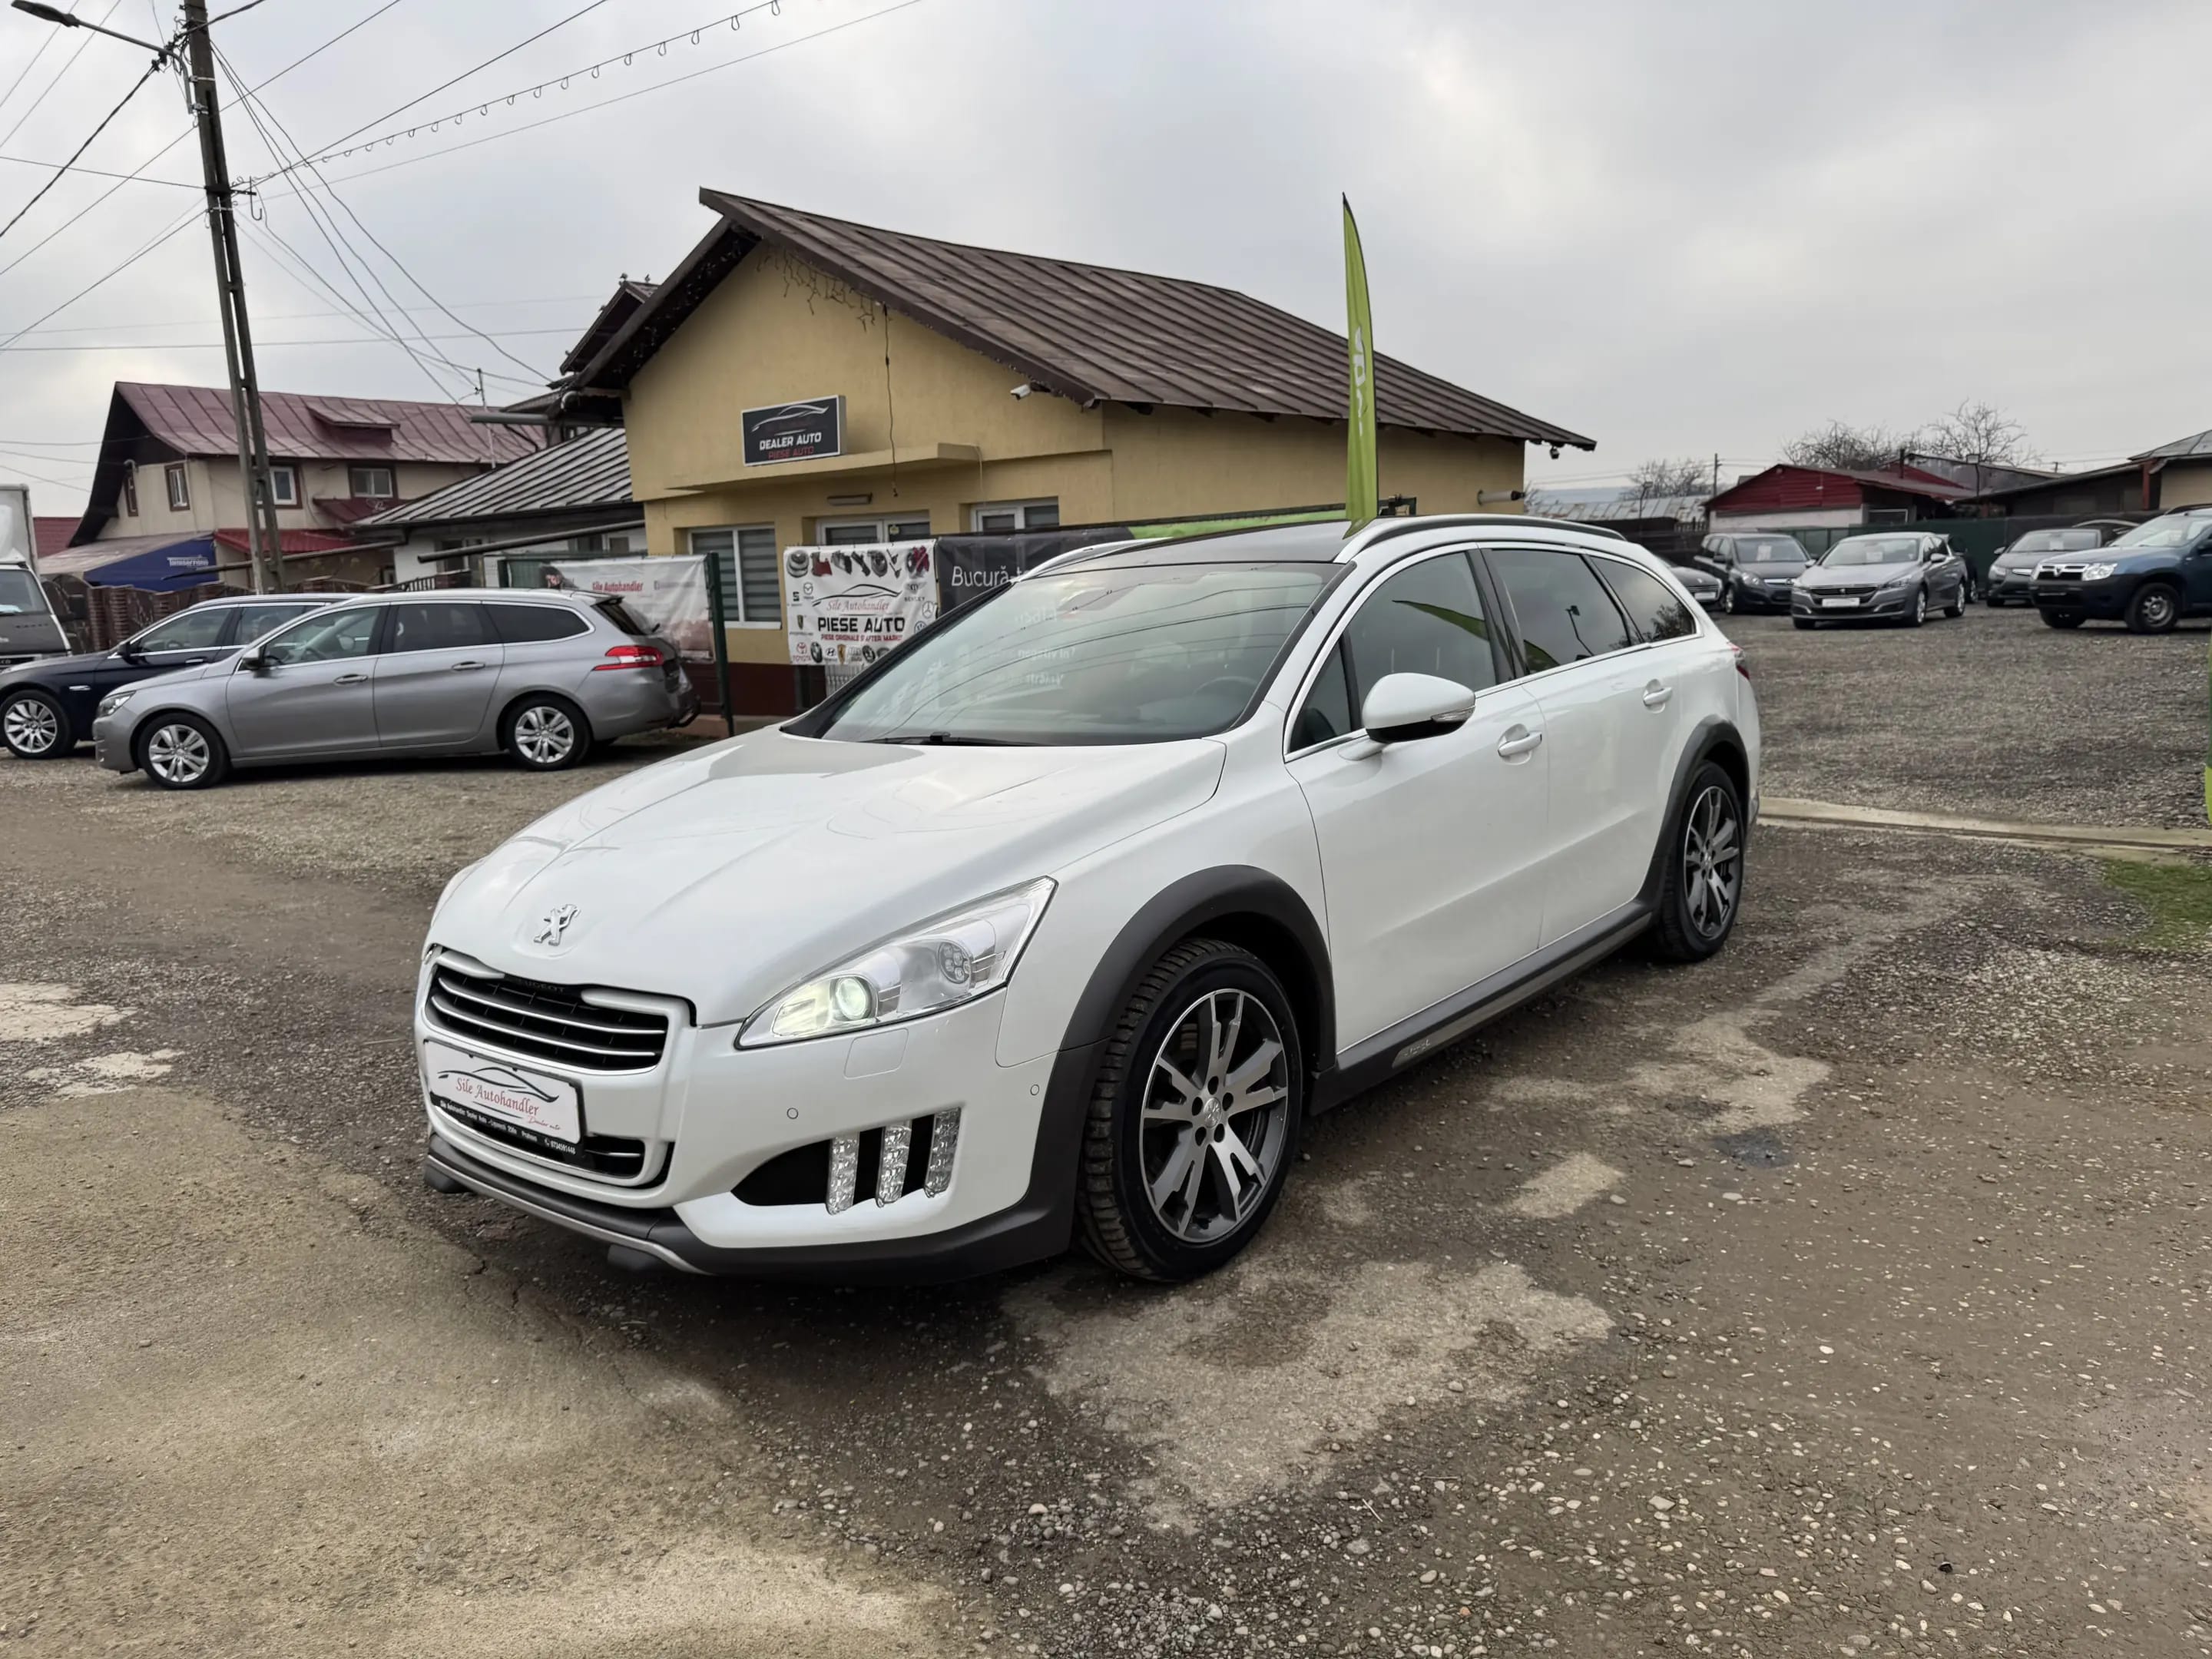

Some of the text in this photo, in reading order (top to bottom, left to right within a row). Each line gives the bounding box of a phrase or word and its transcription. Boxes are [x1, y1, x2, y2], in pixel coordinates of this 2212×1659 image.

[759, 432, 822, 451] DEALER AUTO
[793, 446, 814, 457] AUTO
[604, 581, 644, 592] Autohandler
[843, 599, 889, 612] Autohandler
[818, 617, 905, 632] PIESE AUTO
[456, 1078, 473, 1094] Sile
[475, 1084, 539, 1116] Autohandler
